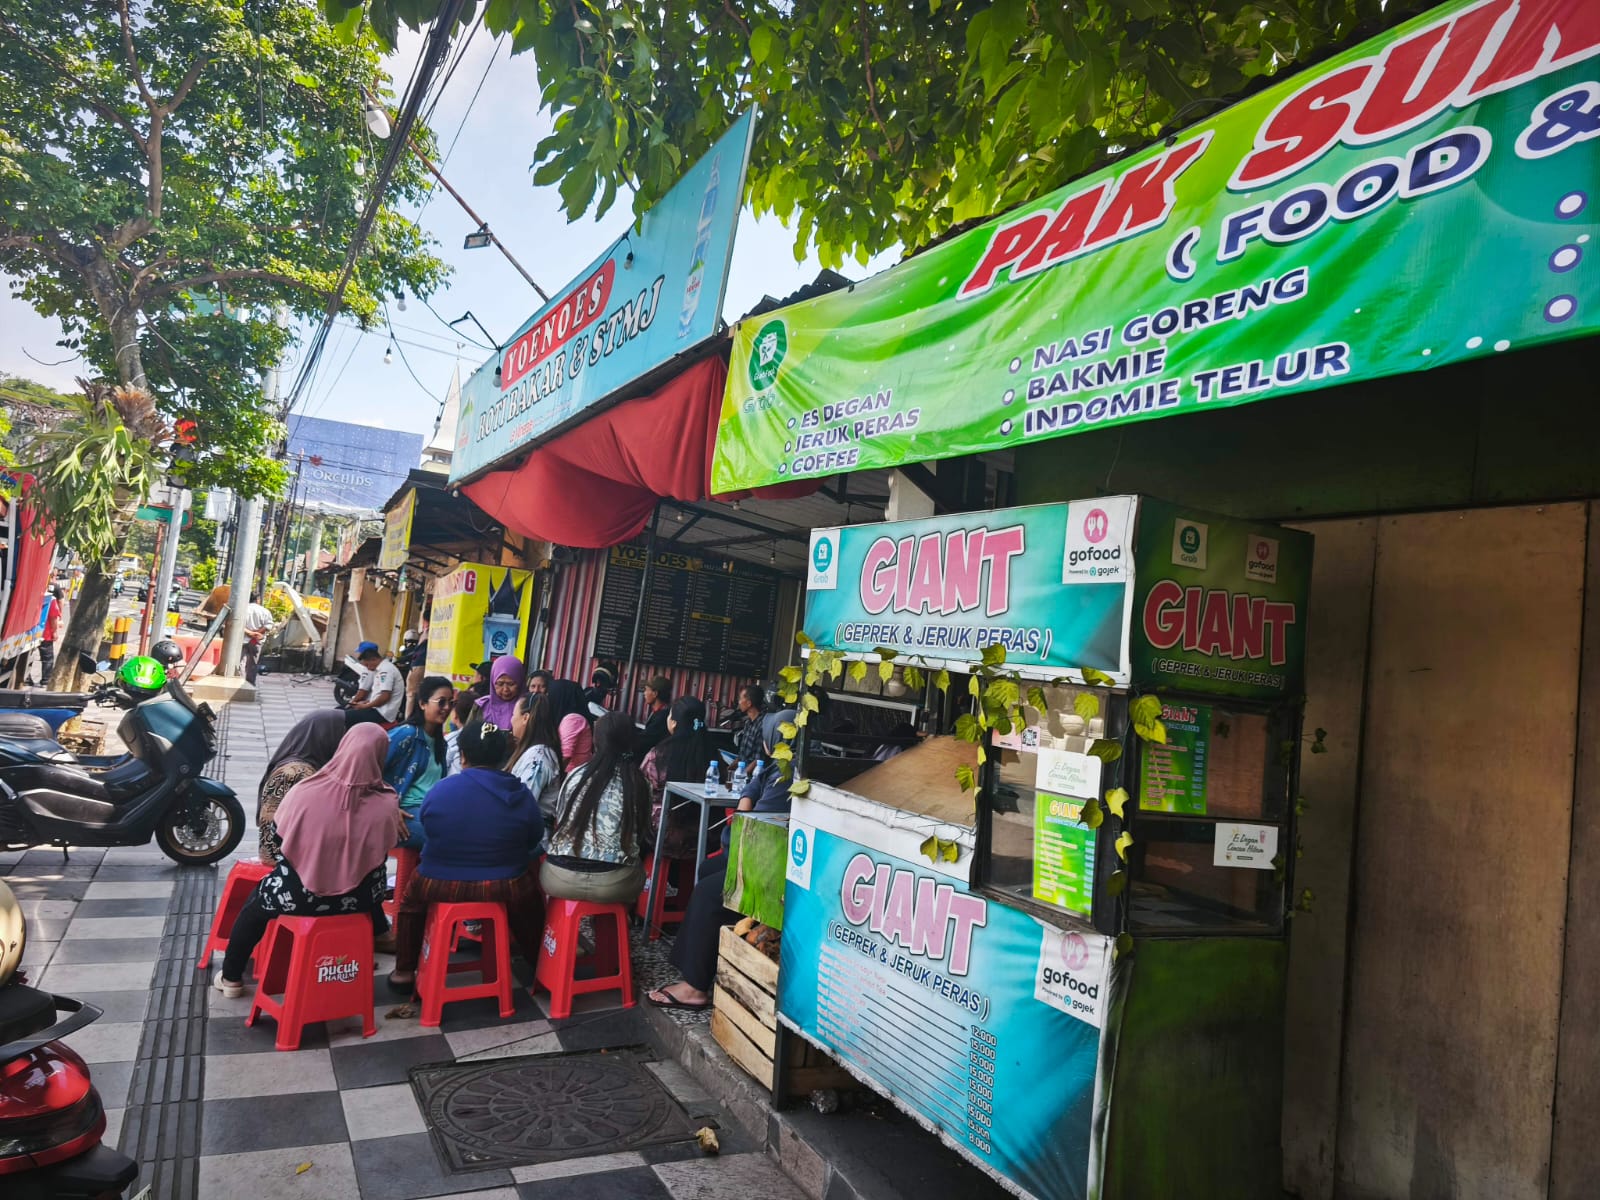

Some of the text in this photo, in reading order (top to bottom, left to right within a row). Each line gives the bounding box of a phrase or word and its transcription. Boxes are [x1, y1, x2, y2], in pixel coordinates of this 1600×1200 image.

[1216, 125, 1492, 263] FOOD
[1515, 81, 1600, 159] &
[956, 130, 1214, 301] PAK
[506, 273, 605, 382] YOENOES
[1032, 266, 1309, 371] NASI GORENG
[477, 395, 508, 442] ROTI
[506, 351, 566, 423] BAKAR
[569, 335, 589, 379] &
[588, 275, 665, 367] STMJ
[1023, 340, 1351, 436] INDOMIE TELUR
[1025, 346, 1167, 402] BAKMIE
[743, 391, 777, 414] Grab
[801, 389, 892, 428] ES DEGAN
[794, 408, 920, 453] JERUK PERAS
[791, 448, 859, 475] COFFEE
[616, 544, 688, 569] YOEOES
[1069, 545, 1121, 566] gofood
[860, 524, 1026, 618] GIANT
[1097, 566, 1120, 577] gojek
[1142, 578, 1296, 666] GIANT
[843, 623, 900, 645] GEPREK
[903, 624, 913, 645] &
[916, 625, 973, 649] JERUK
[975, 627, 1041, 654] PERAS
[1159, 659, 1201, 677] GEPREK
[1203, 666, 1210, 678] &
[1211, 666, 1247, 682] JERUK
[1247, 671, 1281, 687] PERAS
[1161, 703, 1198, 724] GIANT
[841, 852, 987, 977] GIANT
[834, 924, 877, 958] GEPREK
[879, 947, 888, 965] &
[889, 953, 931, 988] JERUK
[932, 973, 981, 1013] PERAS
[1043, 967, 1099, 1000] gofood
[1072, 1000, 1095, 1016] gojek
[970, 1037, 996, 1060] 15.000
[971, 1024, 997, 1046] 12.000
[969, 1051, 995, 1074] 15.000
[969, 1064, 994, 1087] 15.000
[968, 1077, 993, 1100] 15.000
[968, 1090, 992, 1115] 10.000
[967, 1103, 992, 1128] 15.000
